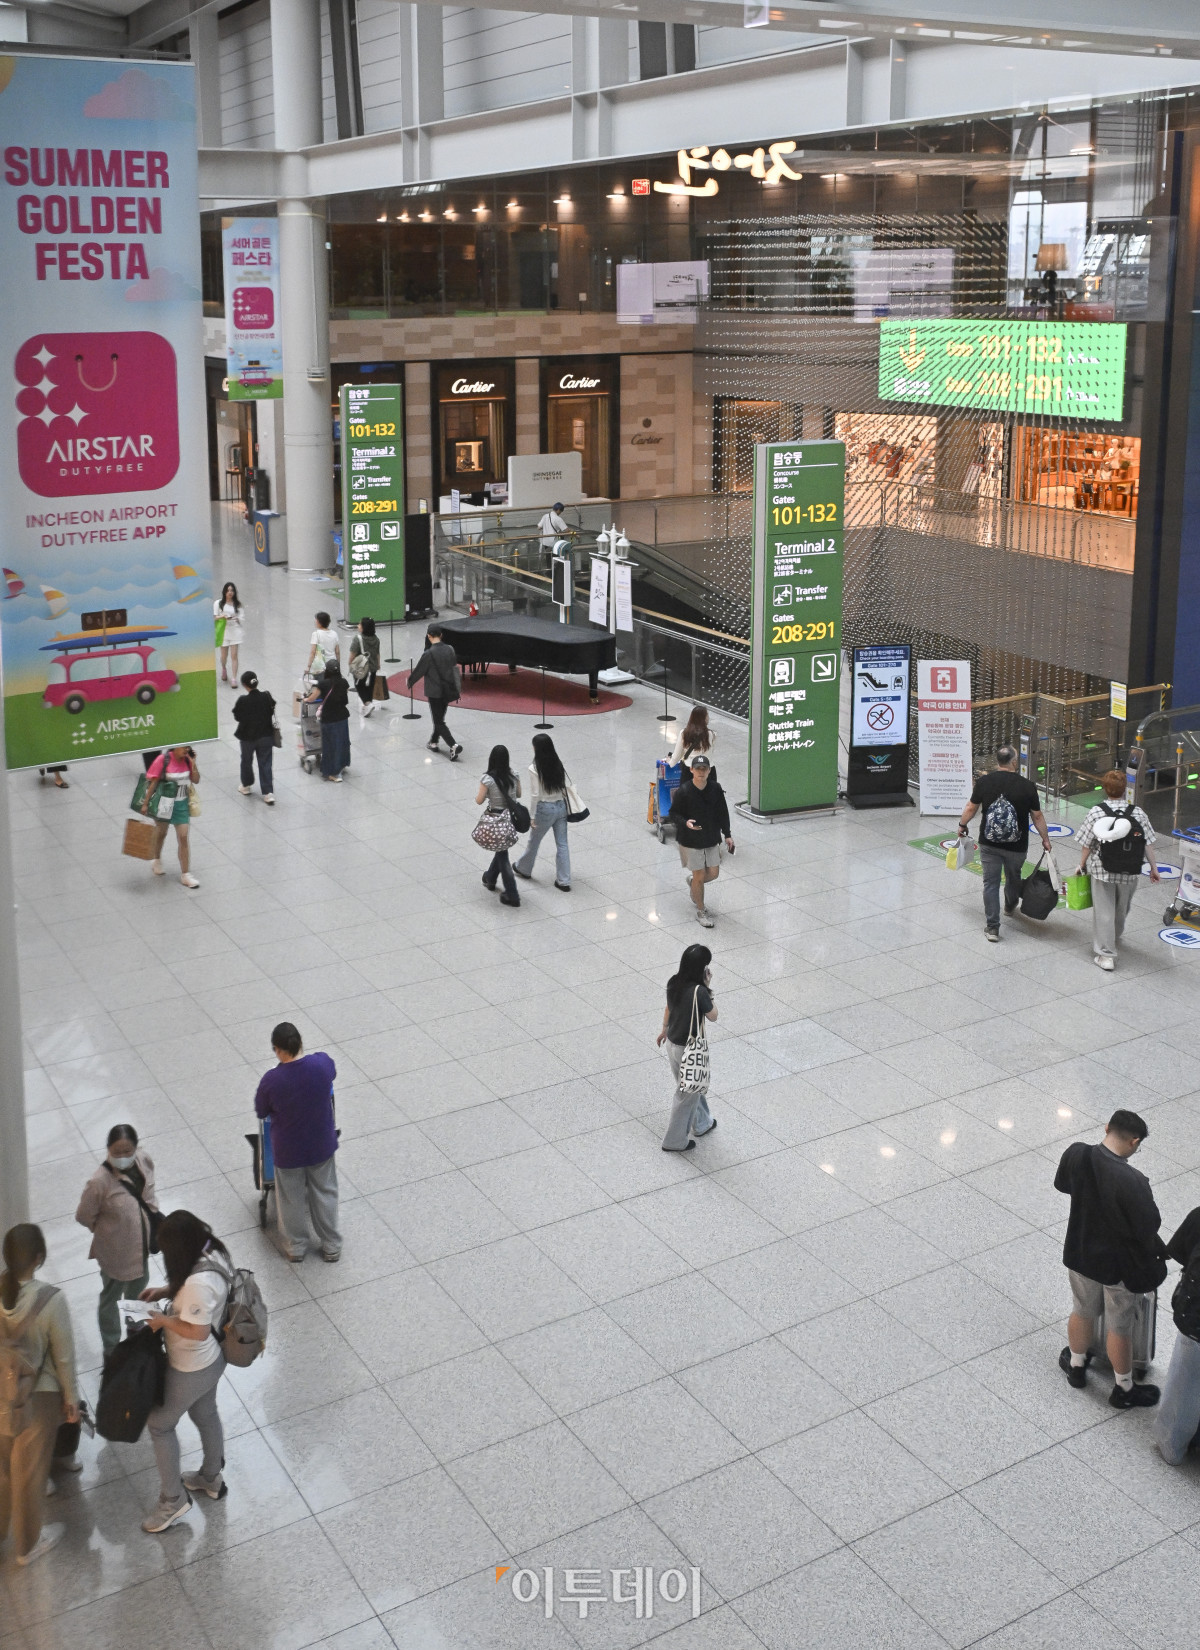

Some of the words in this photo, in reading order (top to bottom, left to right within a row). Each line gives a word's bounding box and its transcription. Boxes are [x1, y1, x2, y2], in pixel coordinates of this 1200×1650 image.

[4, 146, 170, 188] SUMMER
[17, 194, 163, 234] GOLDEN
[35, 242, 150, 281] FESTA
[232, 252, 271, 266] 페스타
[452, 379, 494, 394] Cartier
[560, 374, 600, 389] Cartier
[350, 423, 396, 438] 101-132
[631, 434, 662, 445] Cartier
[46, 434, 156, 463] AIRSTAR
[352, 446, 388, 456] Terminal
[389, 446, 395, 455] 2
[774, 452, 802, 466] 탑승동
[59, 463, 144, 476] DUTYFREE
[352, 500, 397, 514] 208-291
[773, 496, 795, 504] Gates
[25, 509, 104, 528] INCHEON
[108, 503, 178, 522] AIRPORT
[772, 503, 837, 526] 101-132
[41, 528, 128, 548] DUTYFREE
[132, 525, 166, 540] APP
[774, 539, 825, 555] Terminal
[827, 539, 835, 551] 2
[795, 585, 828, 595] Transfer
[772, 614, 794, 623] Gates
[772, 621, 834, 644] 208-291
[769, 705, 784, 716] 타는
[786, 704, 793, 714] 곳
[922, 701, 936, 709] 약국
[952, 702, 967, 710] 안내
[96, 714, 155, 734] AIRSTAR
[768, 721, 794, 731] Shuttle
[795, 719, 814, 728] Train
